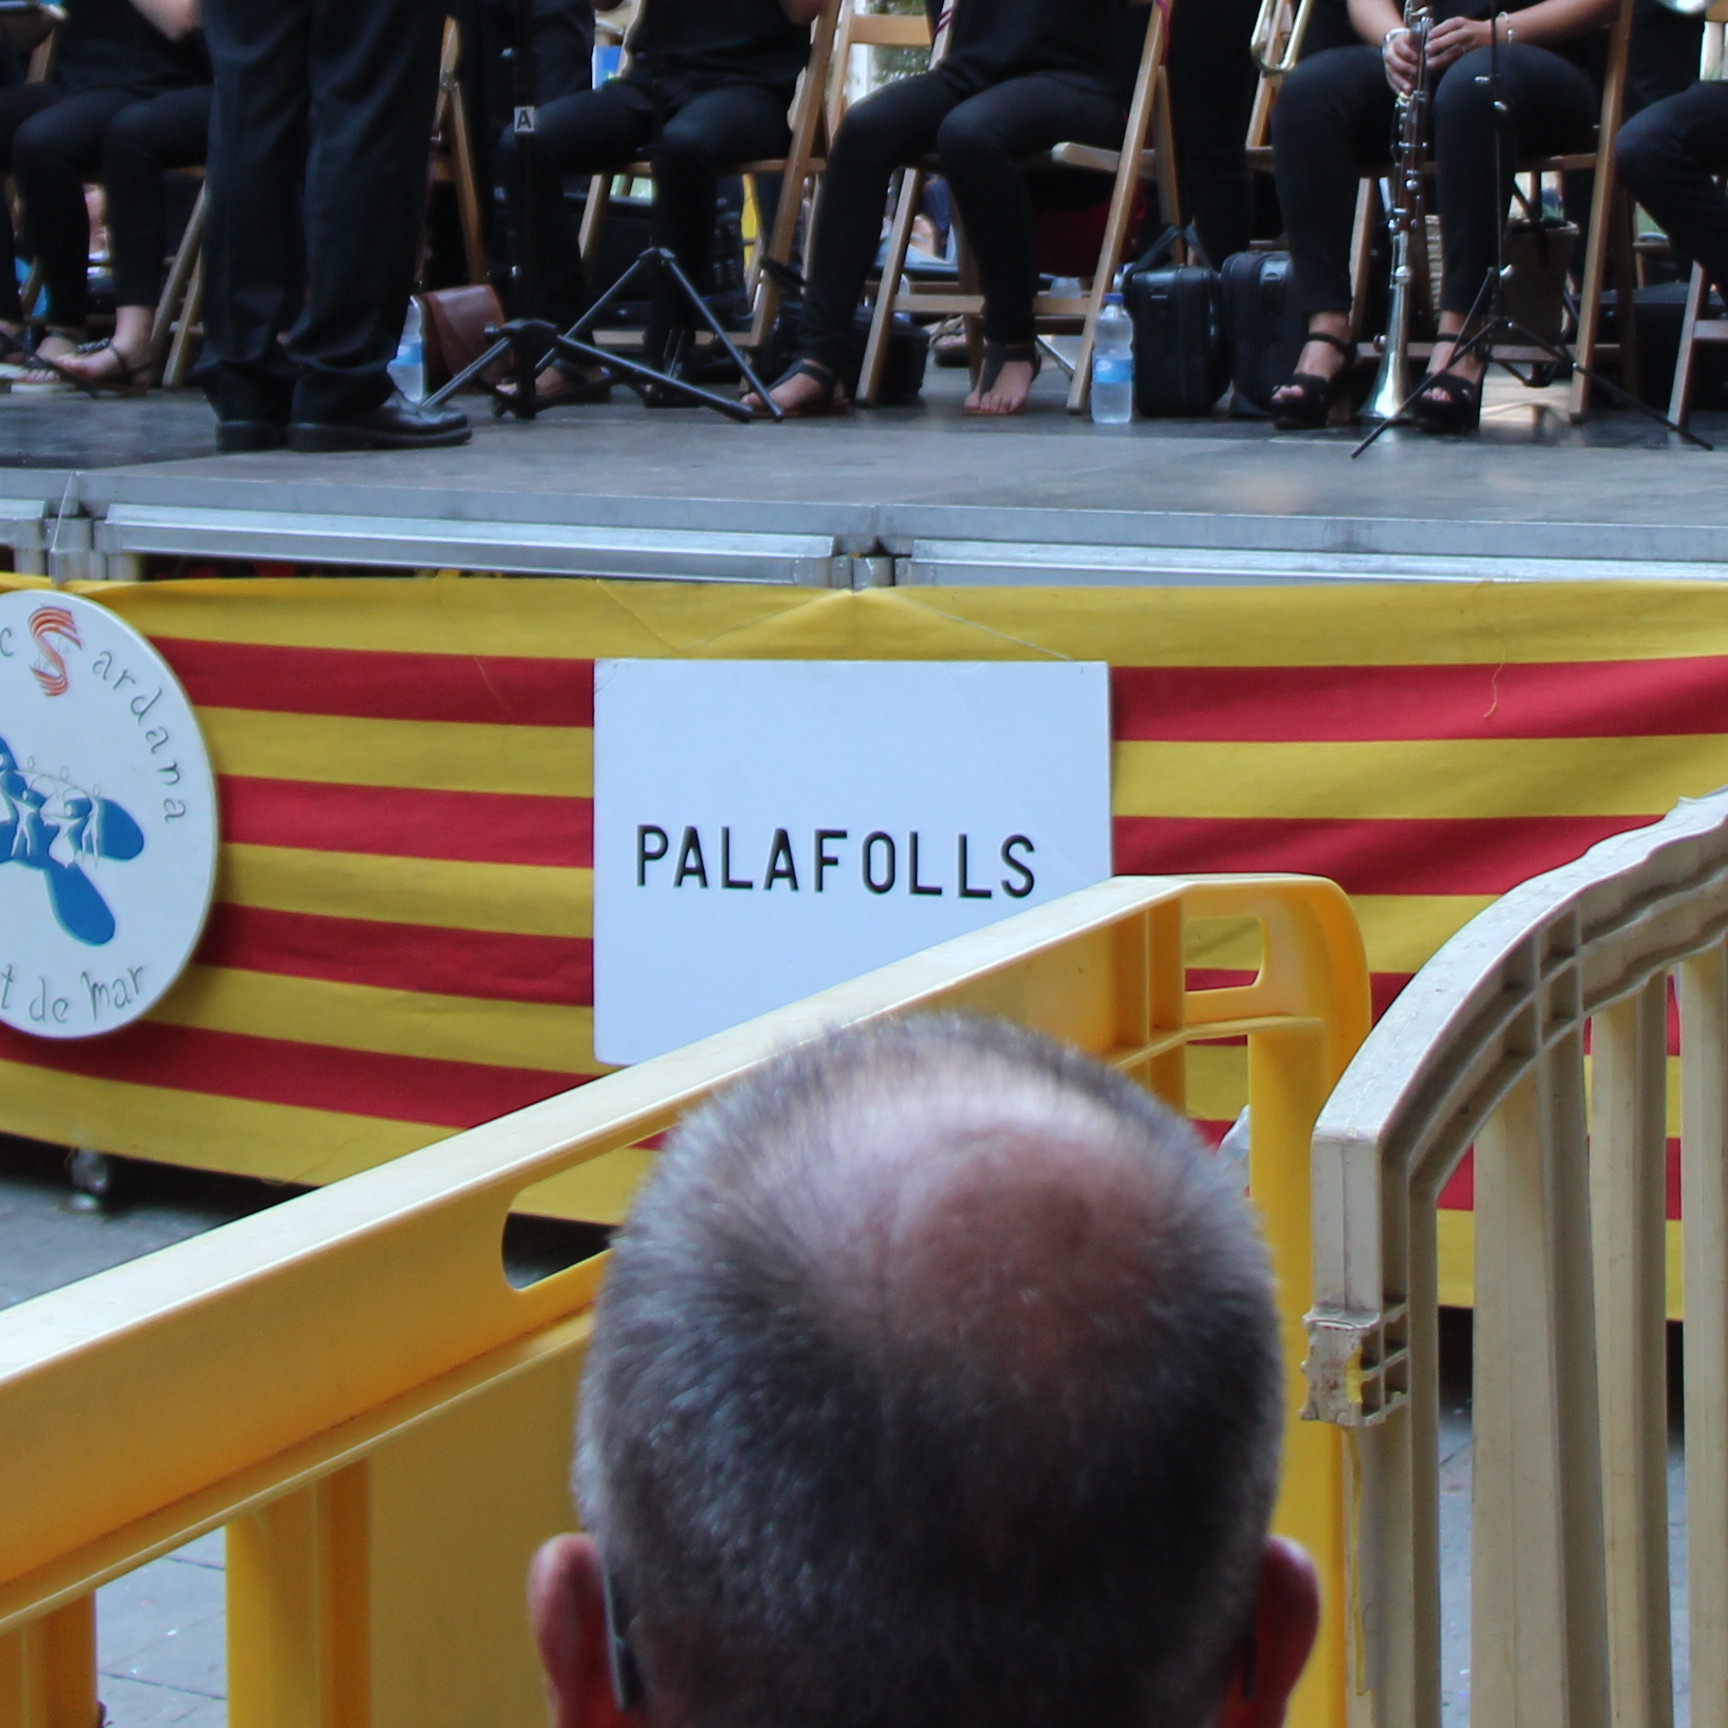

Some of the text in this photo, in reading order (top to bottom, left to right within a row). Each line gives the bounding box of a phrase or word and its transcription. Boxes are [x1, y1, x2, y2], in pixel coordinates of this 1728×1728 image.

[516, 109, 532, 129] A
[637, 824, 1036, 899] PALAFOLLS
[28, 978, 69, 1024] de
